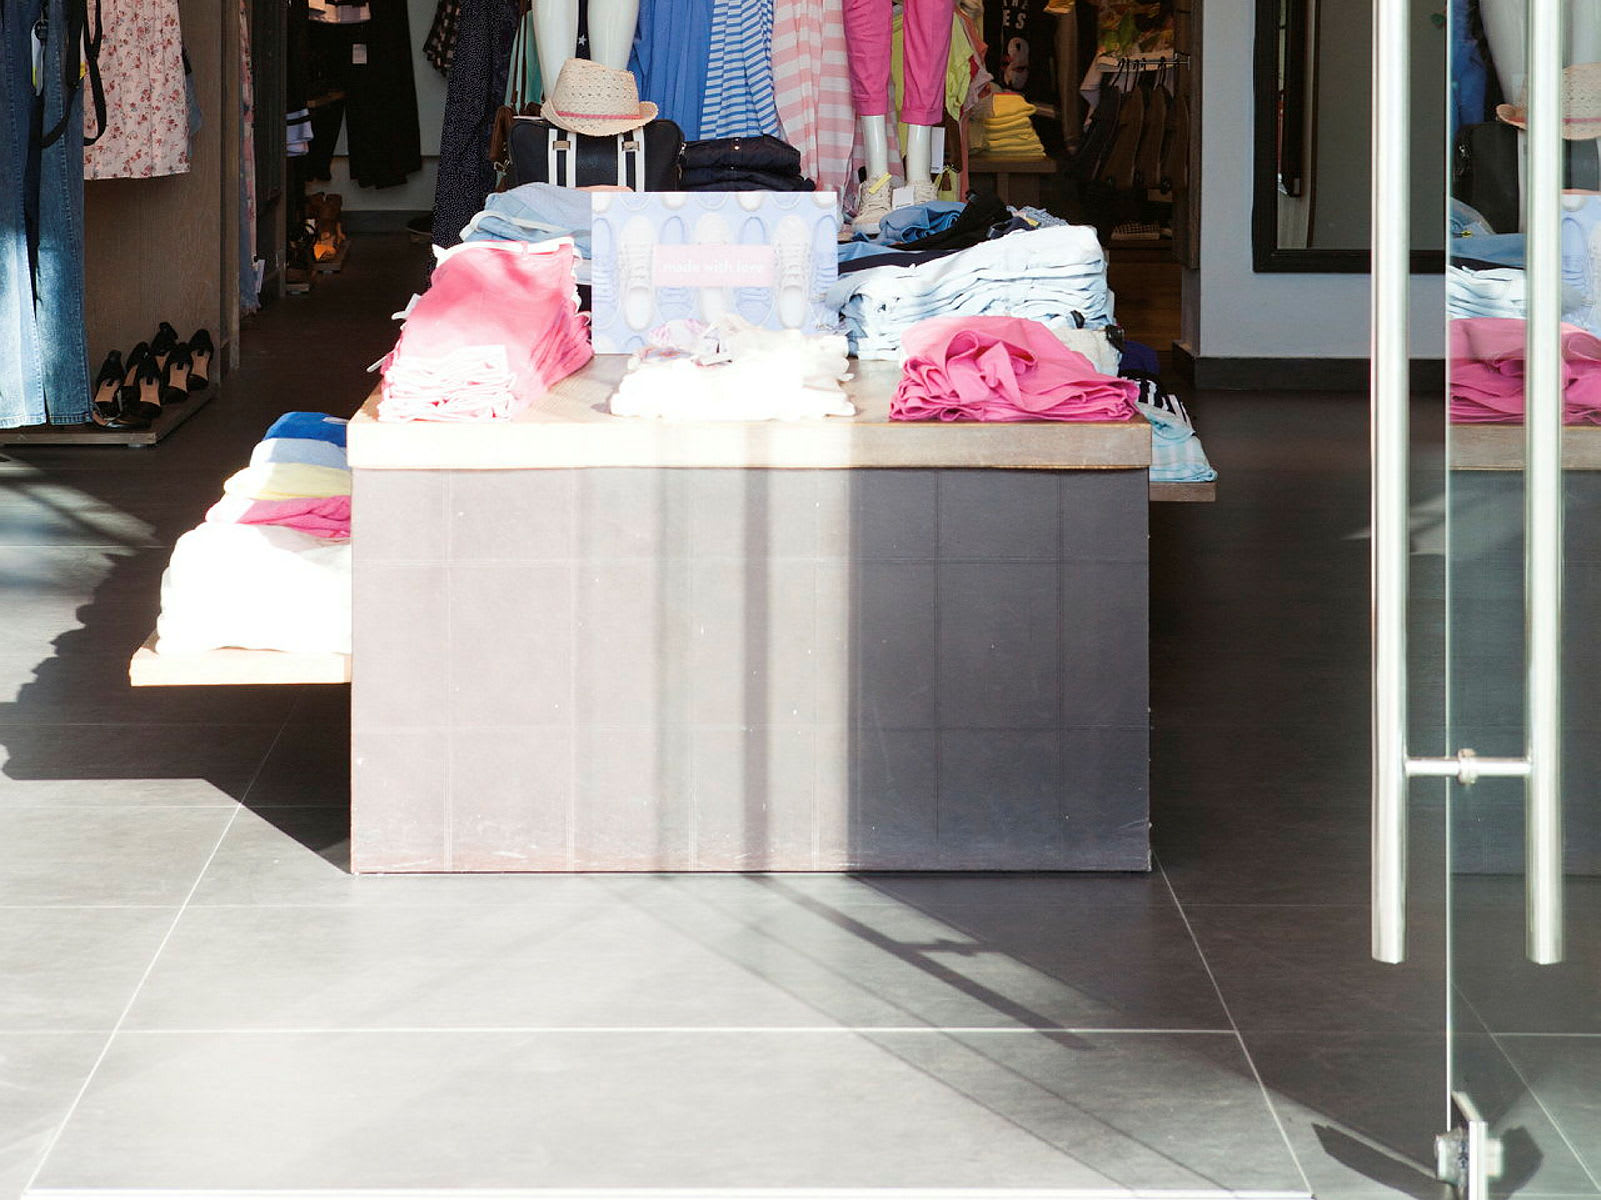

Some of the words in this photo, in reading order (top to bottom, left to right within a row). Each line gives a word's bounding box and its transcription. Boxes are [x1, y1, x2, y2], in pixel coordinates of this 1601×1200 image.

[661, 258, 699, 273] made
[703, 258, 732, 273] with
[736, 258, 764, 273] love
